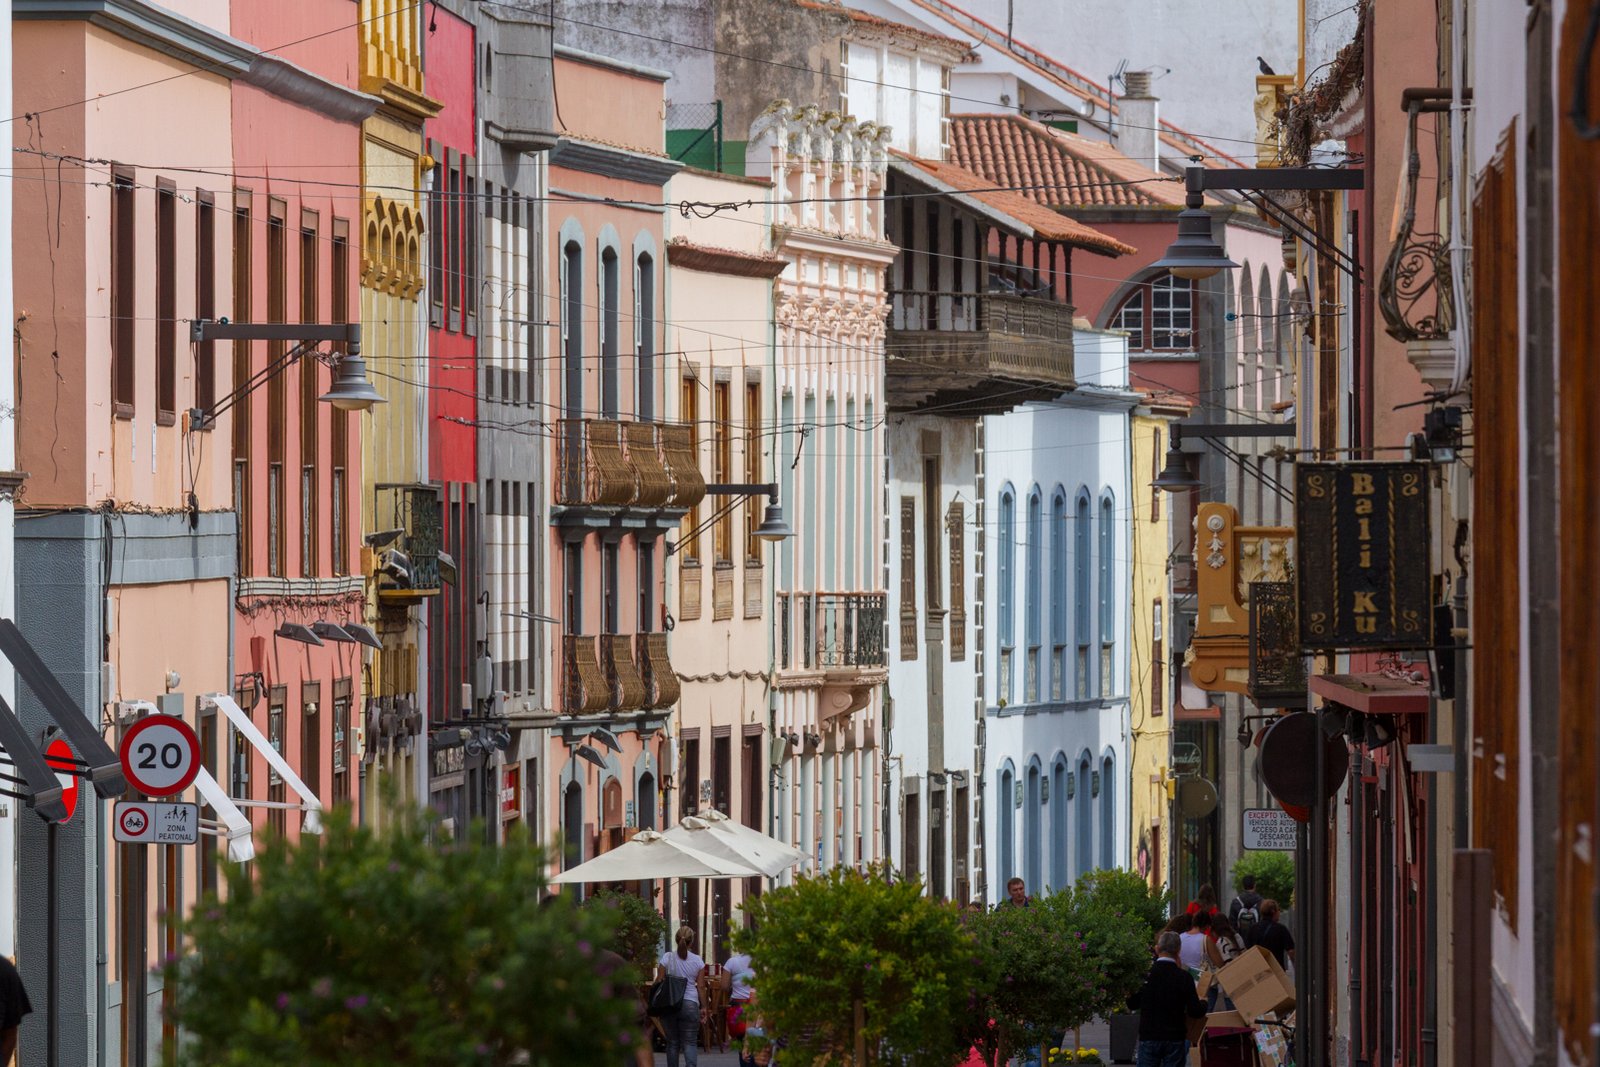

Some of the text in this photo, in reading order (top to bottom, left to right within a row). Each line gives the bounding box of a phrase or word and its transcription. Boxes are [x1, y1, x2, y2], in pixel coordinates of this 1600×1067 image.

[1351, 472, 1380, 634] Bali Ku
[137, 743, 182, 769] 20
[158, 833, 193, 841] PEATONAL
